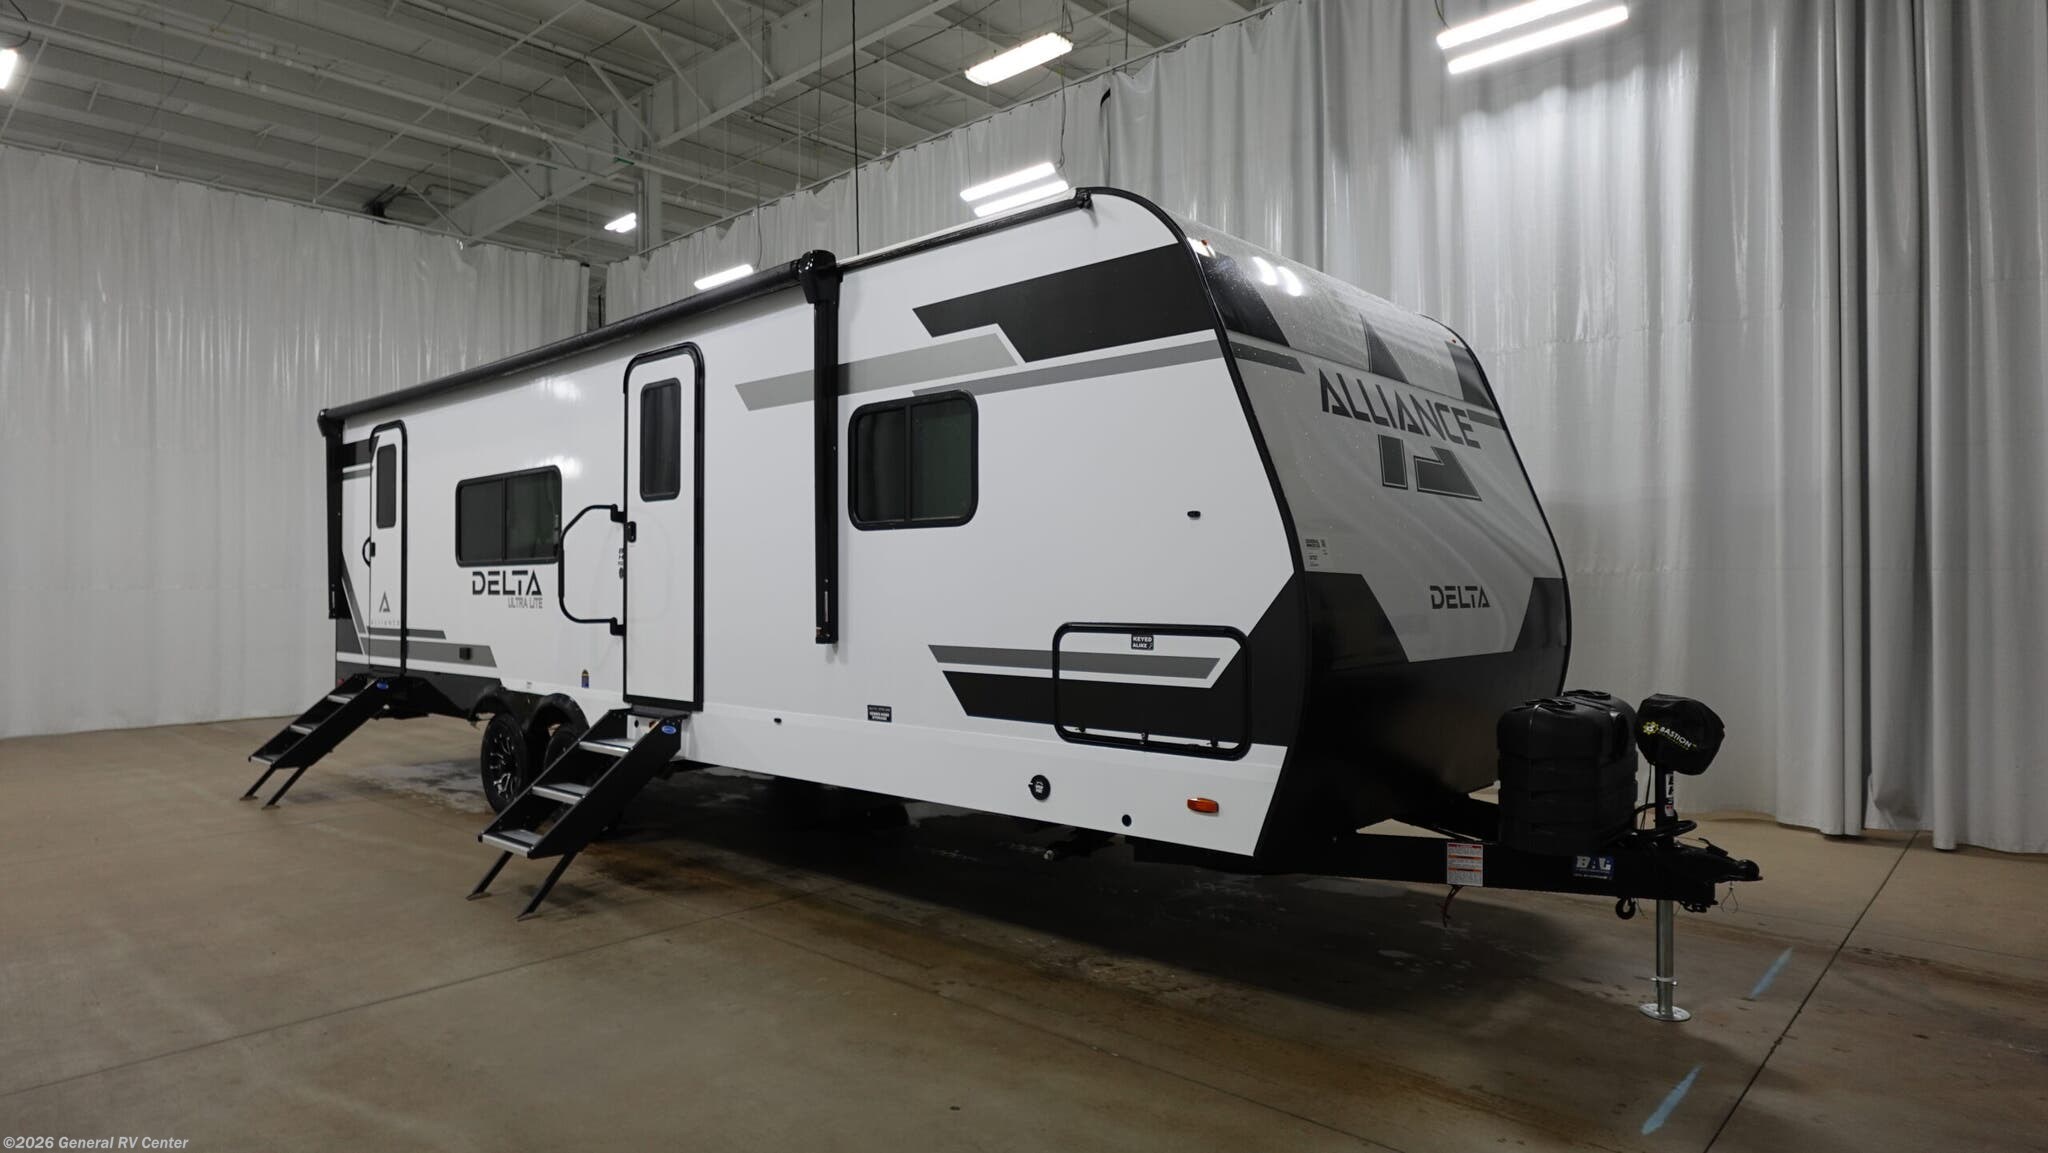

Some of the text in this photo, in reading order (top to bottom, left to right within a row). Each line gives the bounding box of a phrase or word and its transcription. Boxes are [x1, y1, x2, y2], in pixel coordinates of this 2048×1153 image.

[1319, 368, 1481, 449] ALLIANCE
[472, 569, 542, 595] DELTA
[508, 597, 543, 609] ULTRA LITE
[1429, 585, 1491, 609] DELTA
